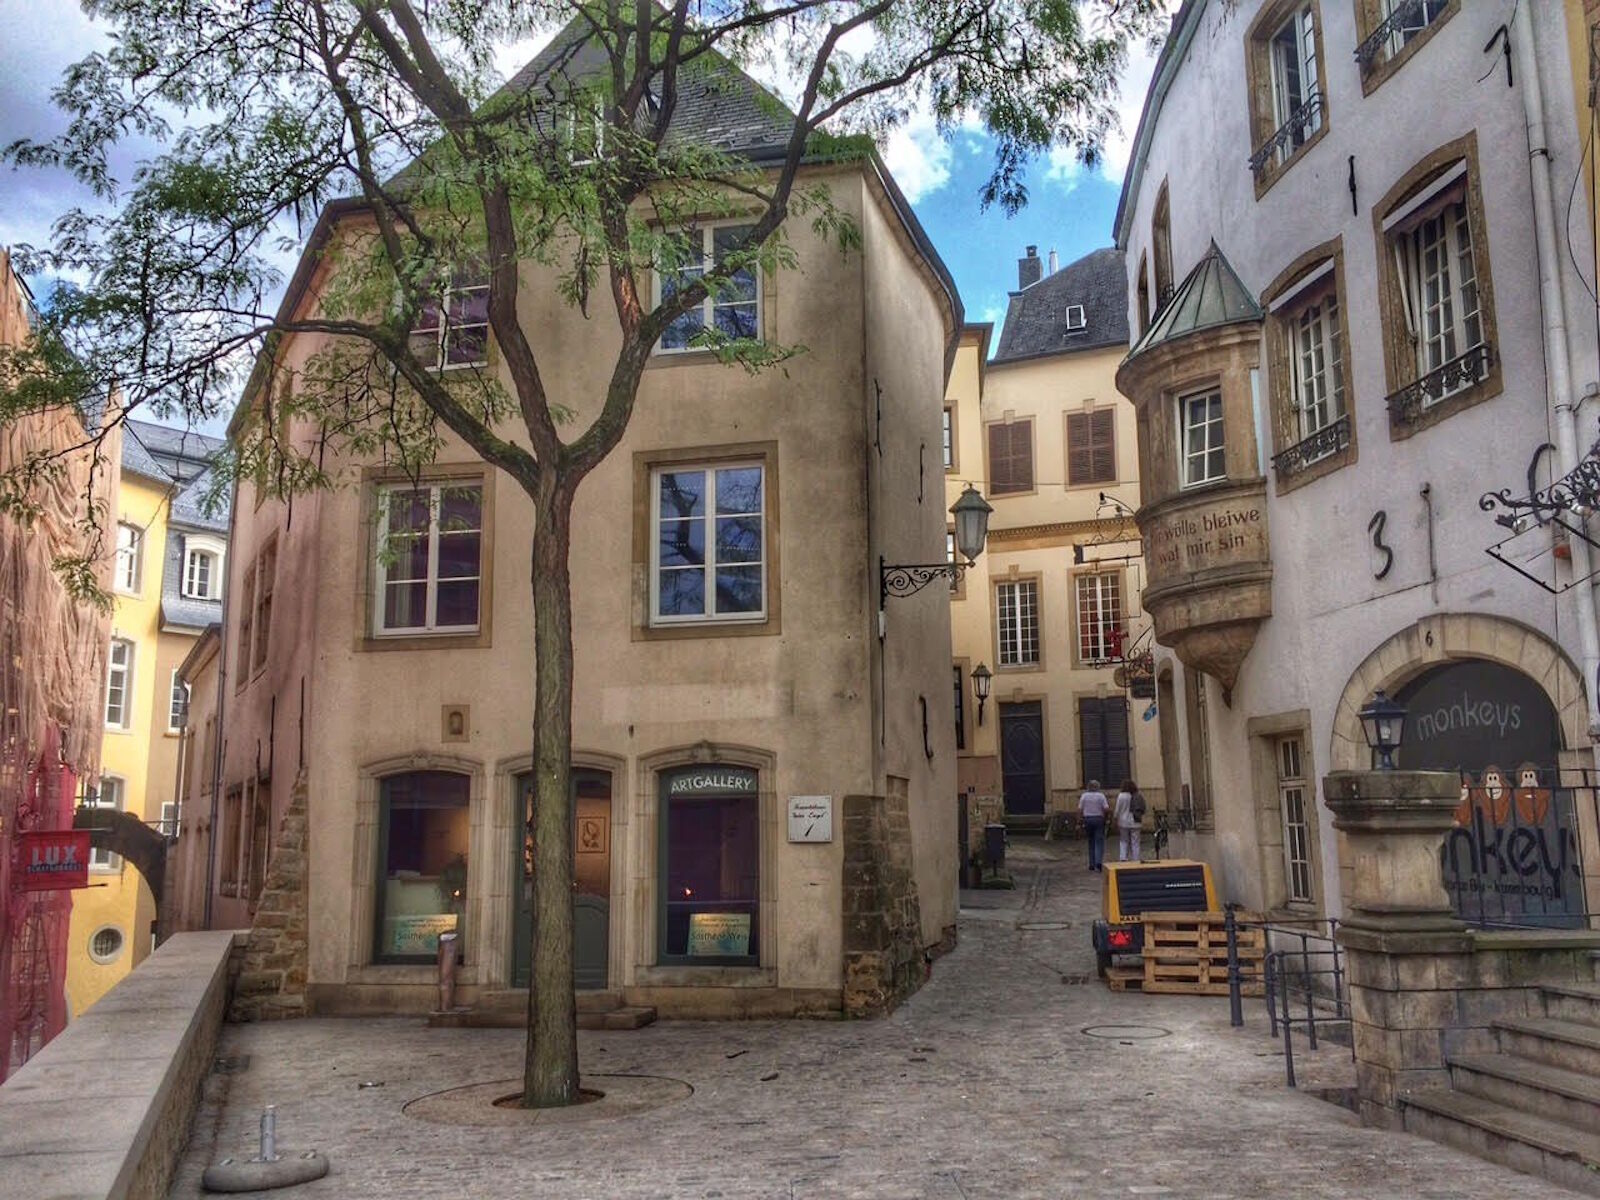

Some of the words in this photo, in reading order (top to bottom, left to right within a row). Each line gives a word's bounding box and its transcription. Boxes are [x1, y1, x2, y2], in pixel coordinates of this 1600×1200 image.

[1203, 509, 1260, 532] bleiwe
[1159, 545, 1179, 564] wat
[1186, 538, 1212, 557] mir
[1219, 533, 1244, 550] sin
[1425, 630, 1433, 648] 6
[1417, 690, 1521, 741] monkeys
[32, 845, 77, 865] LUX
